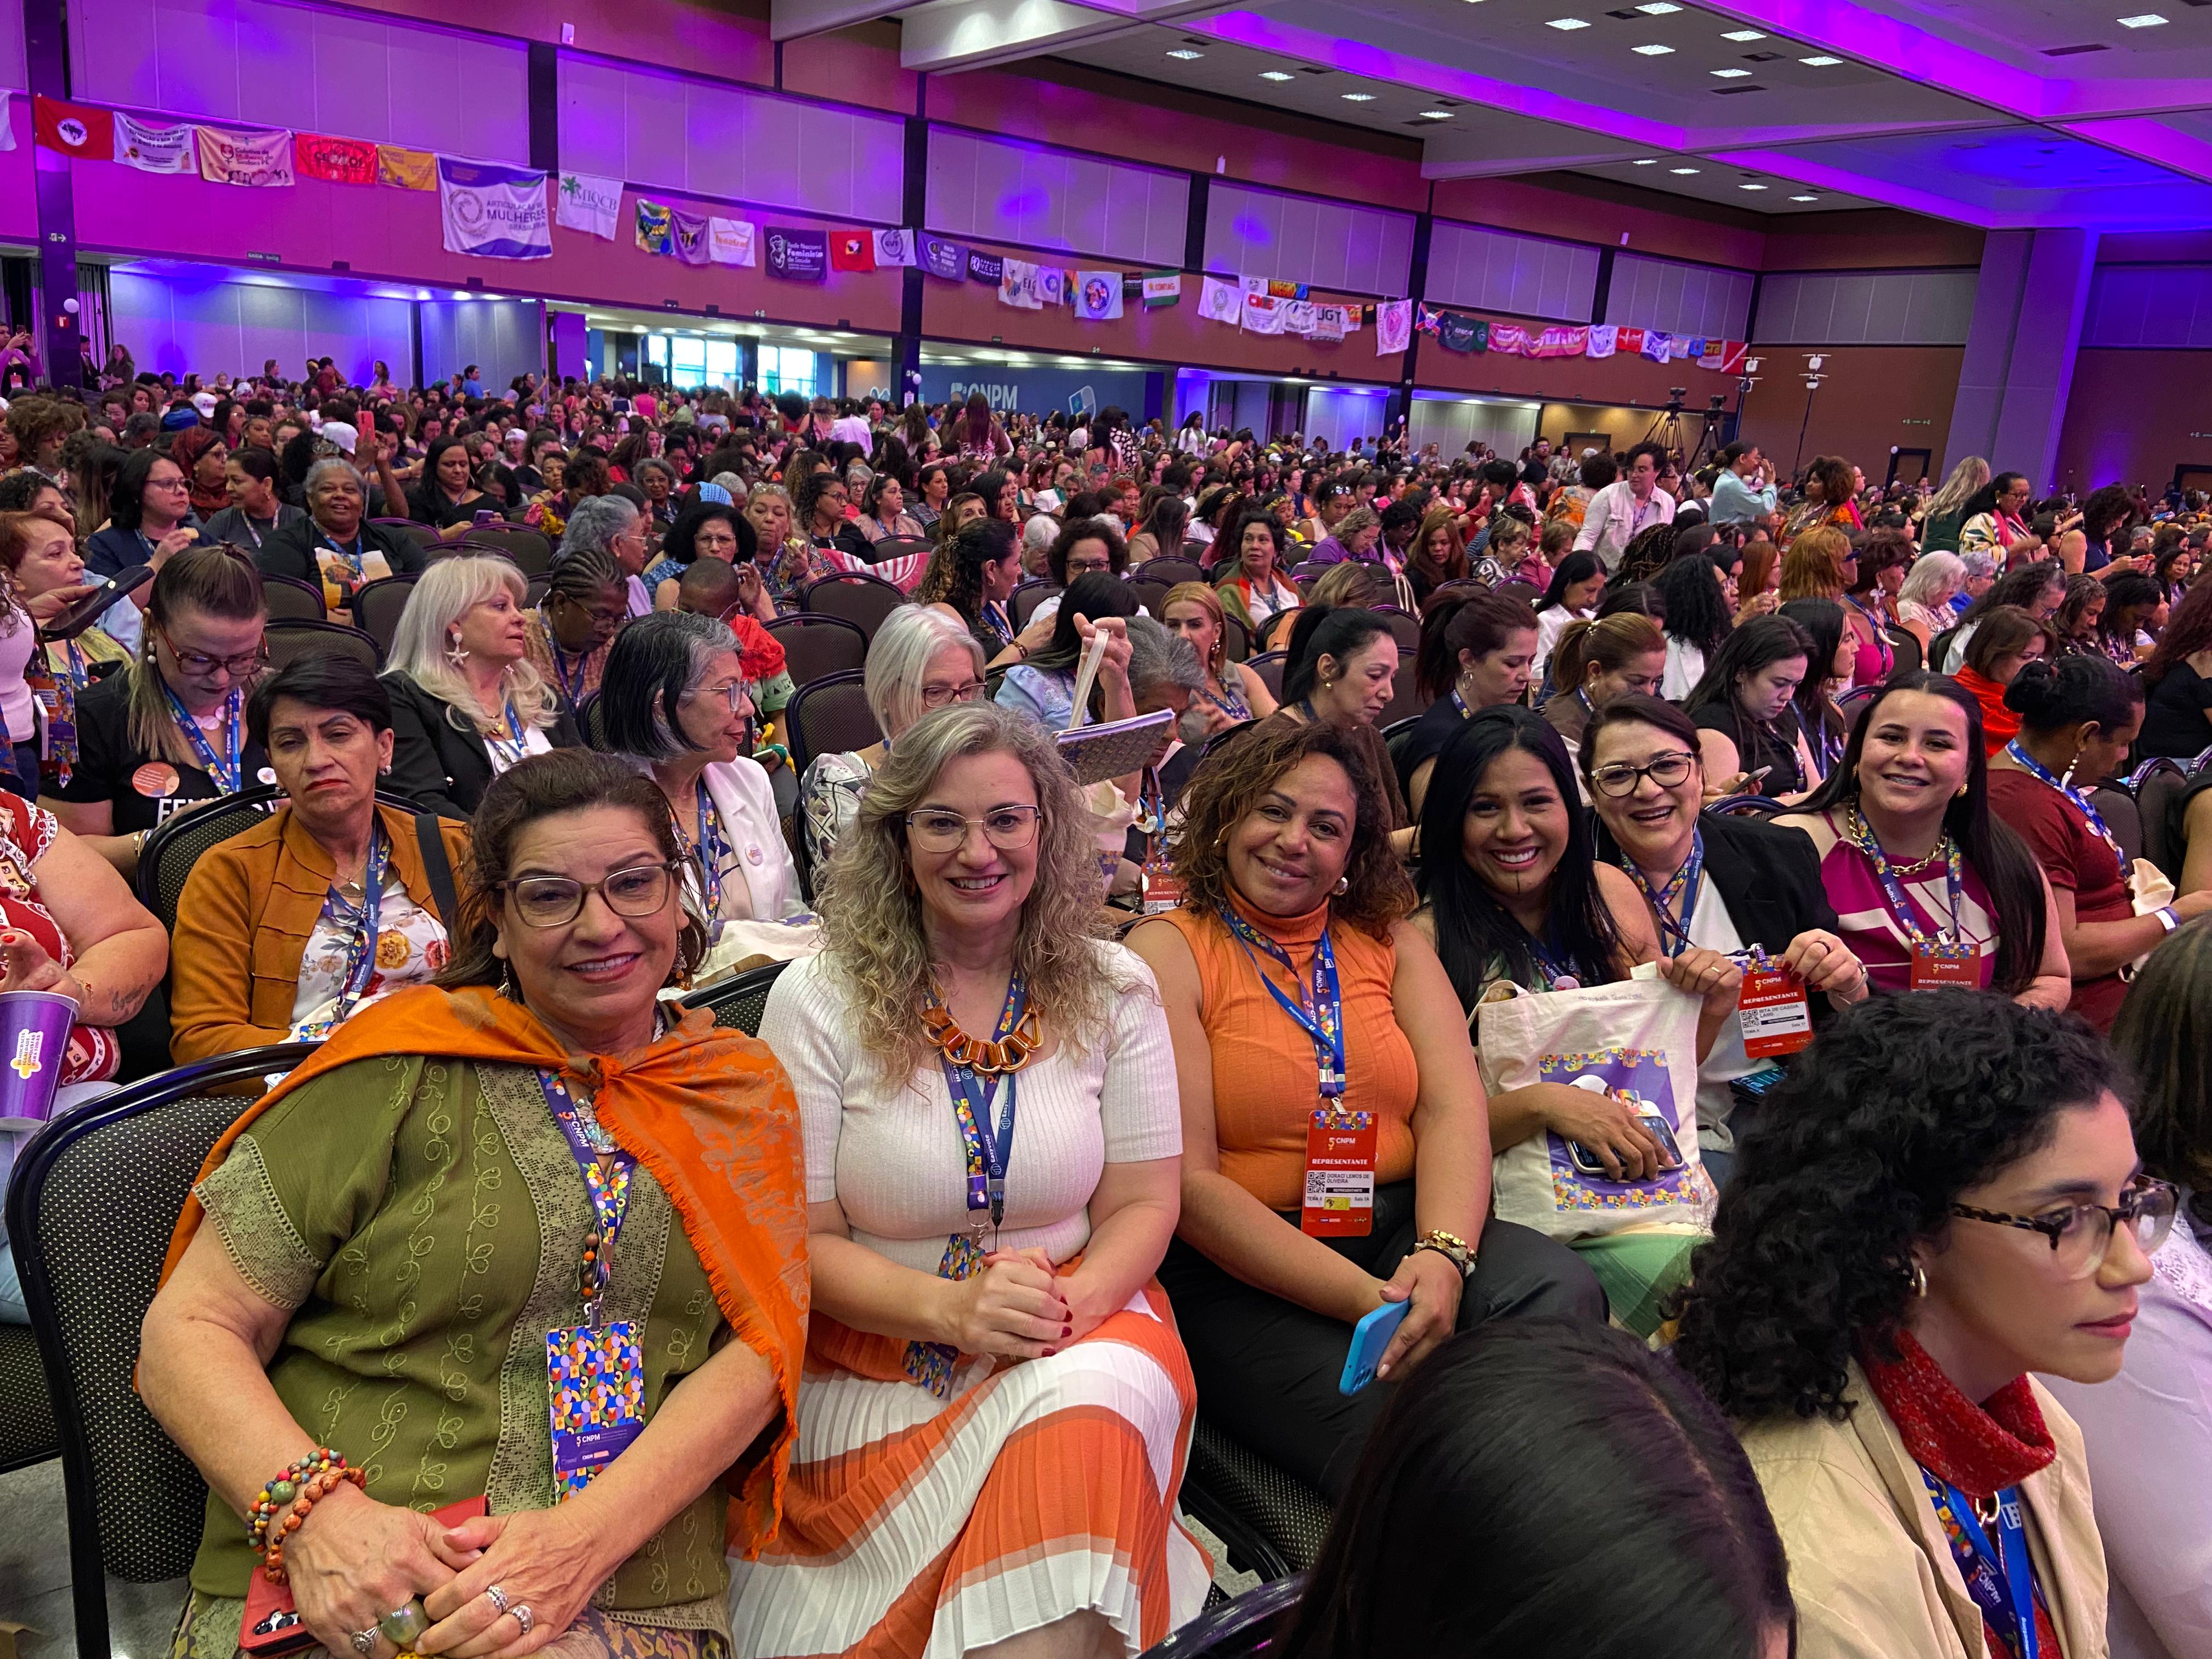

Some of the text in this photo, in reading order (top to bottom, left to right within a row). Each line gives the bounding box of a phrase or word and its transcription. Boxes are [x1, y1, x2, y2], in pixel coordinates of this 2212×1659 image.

[487, 208, 546, 223] MULHERES
[787, 249, 823, 257] Feminista
[1884, 884, 1897, 902] CNPM
[1743, 992, 1798, 1005] REPRESENTANTE
[571, 1121, 590, 1148] CNPM
[985, 1135, 995, 1164] Easyvote
[582, 1434, 601, 1443] CNPM
[1979, 1572, 2002, 1605] CNPM
